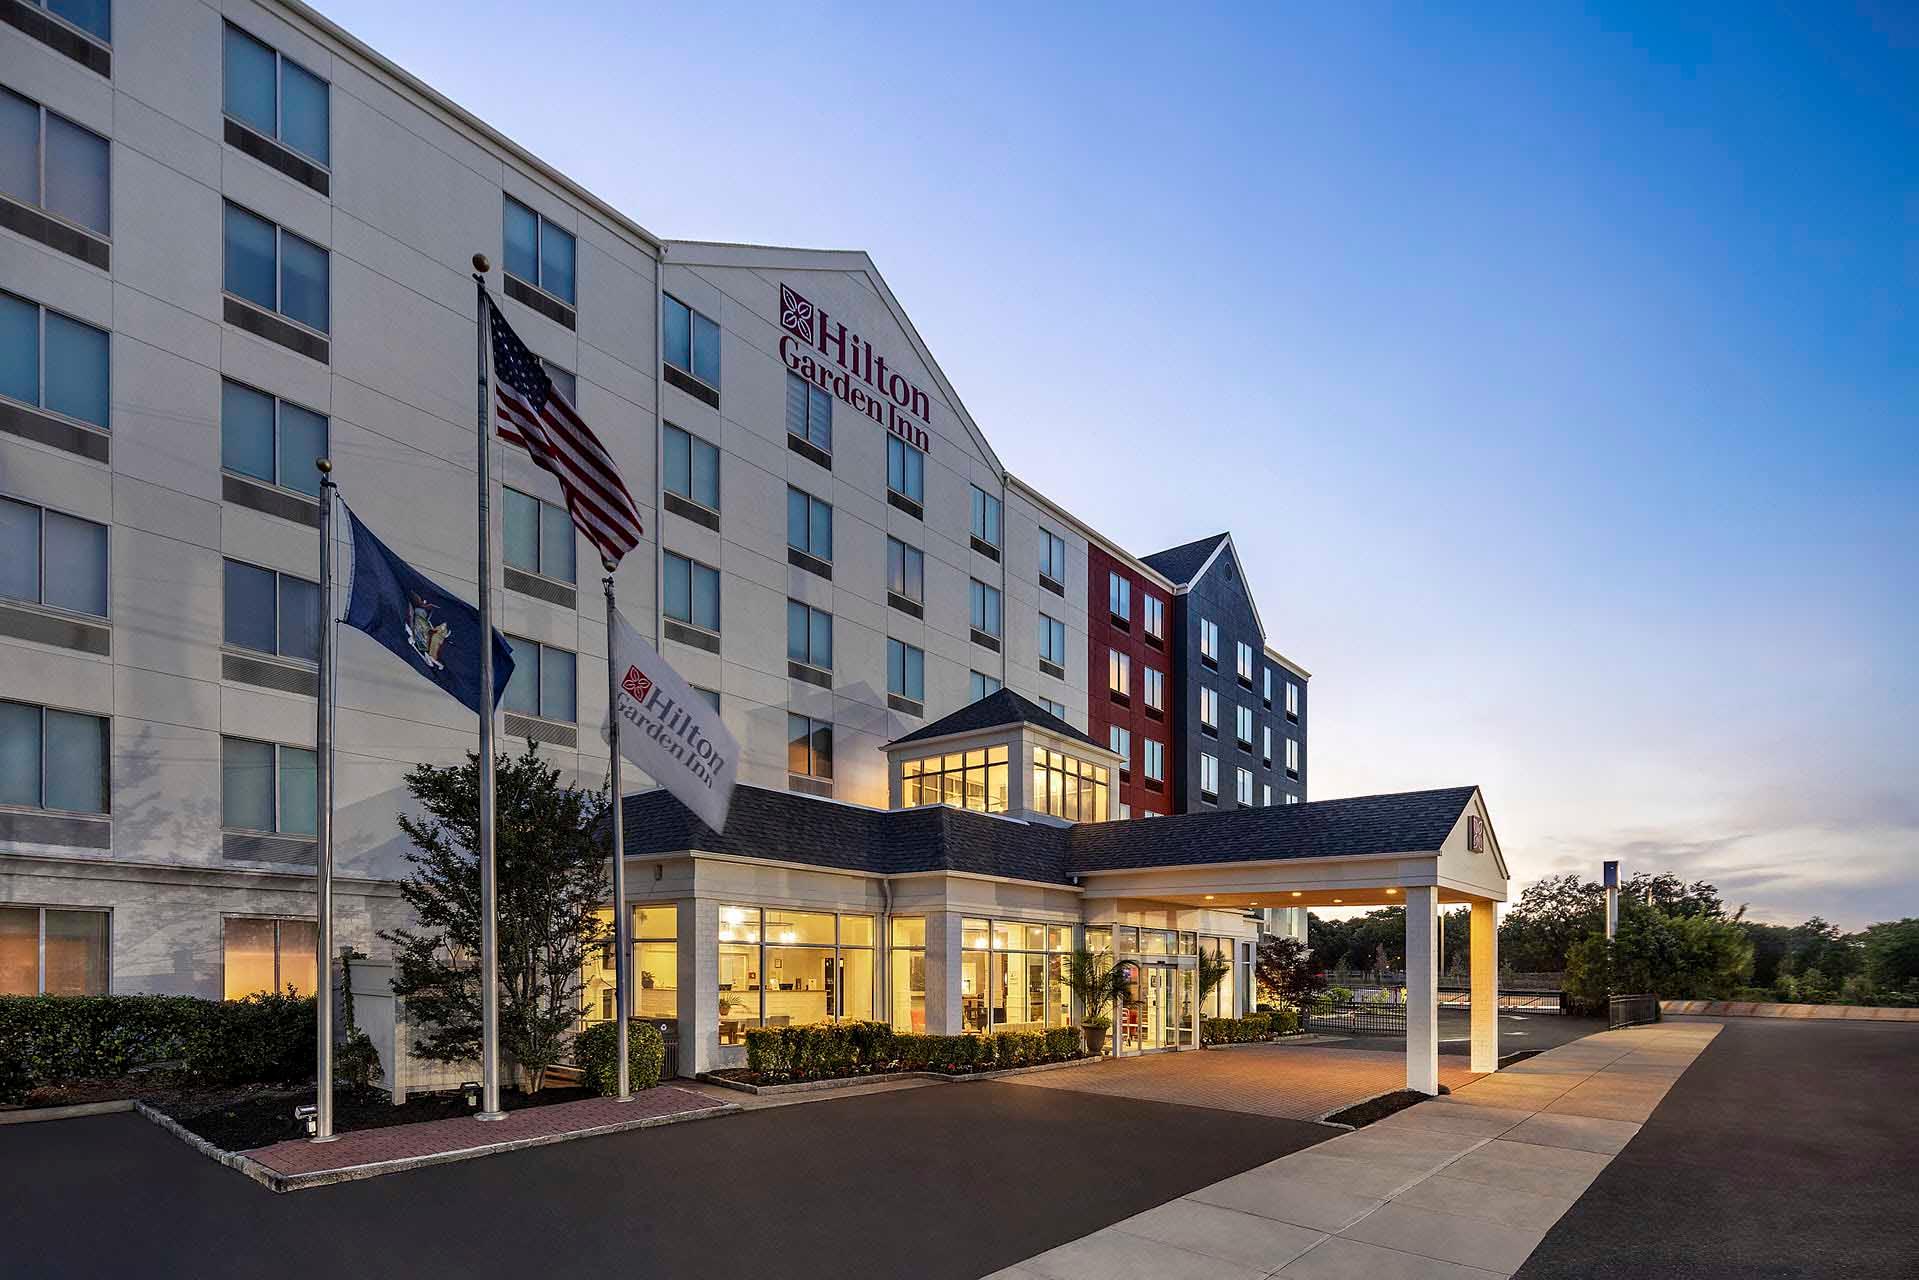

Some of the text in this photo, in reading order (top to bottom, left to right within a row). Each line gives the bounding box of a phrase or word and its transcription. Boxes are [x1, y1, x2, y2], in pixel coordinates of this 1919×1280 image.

[779, 335, 931, 455] Garden Inn
[817, 308, 931, 425] Hilton
[645, 686, 725, 776] Hilton
[684, 750, 713, 789] Inn
